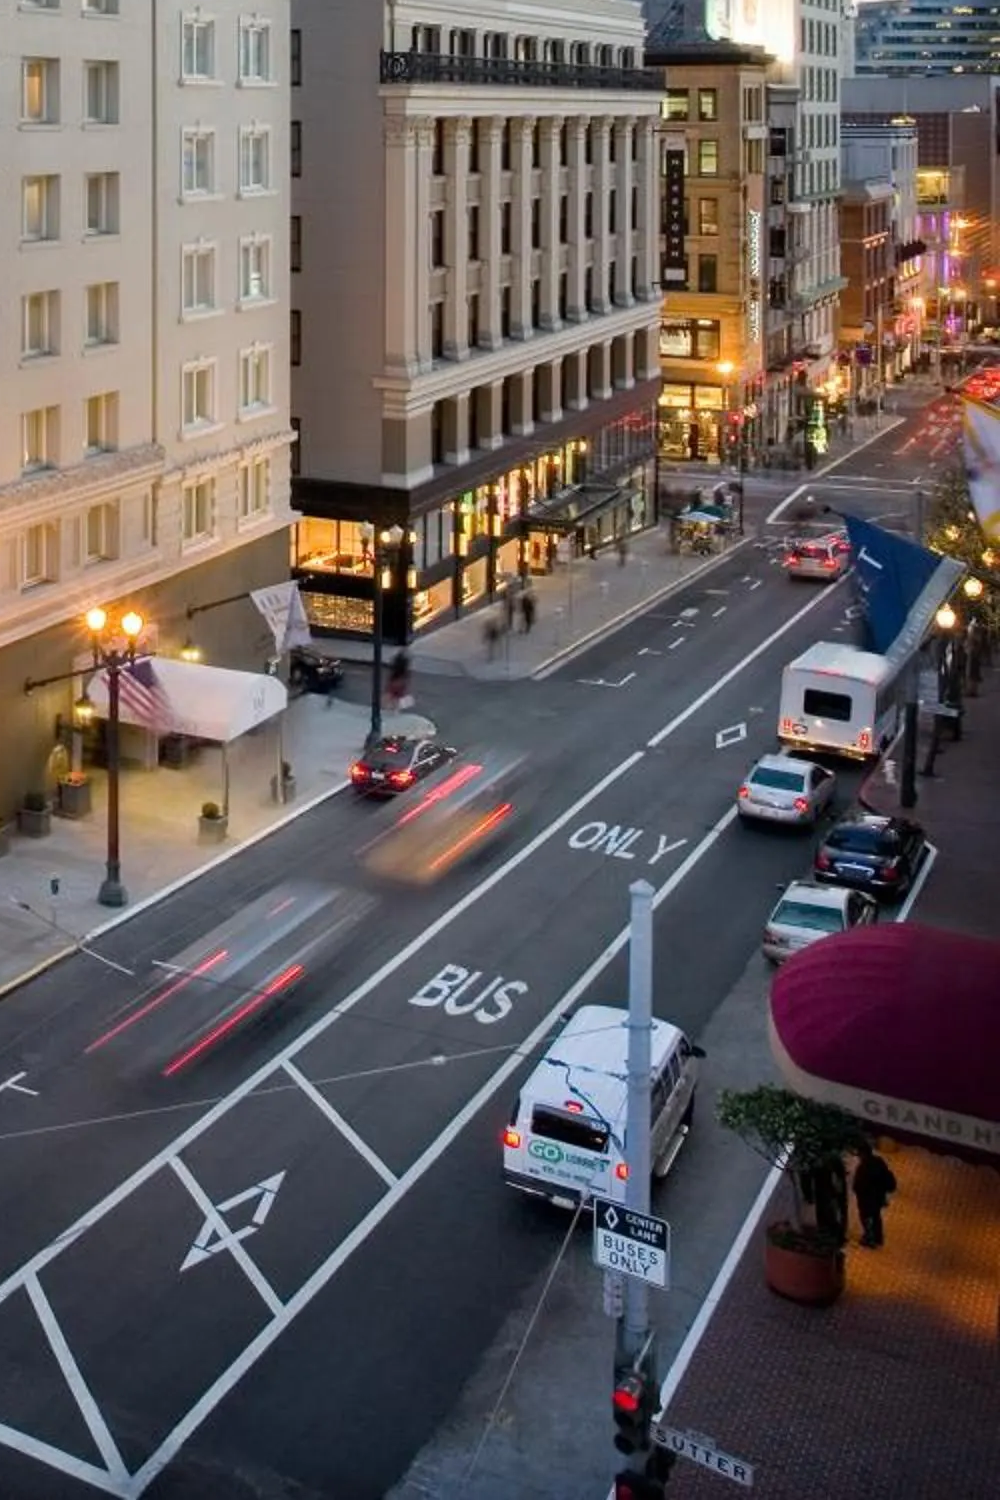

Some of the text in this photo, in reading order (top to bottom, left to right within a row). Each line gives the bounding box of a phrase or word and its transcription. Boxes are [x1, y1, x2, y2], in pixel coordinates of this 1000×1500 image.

[568, 821, 688, 865] ONLY
[407, 963, 529, 1025] BUS
[863, 1100, 963, 1136] GRAND
[529, 1140, 562, 1162] GO
[625, 1213, 663, 1234] CENTER
[630, 1226, 658, 1243] LANE
[603, 1235, 658, 1265] BUSES
[609, 1251, 651, 1276] ONLY
[655, 1428, 746, 1481] SUTTER
